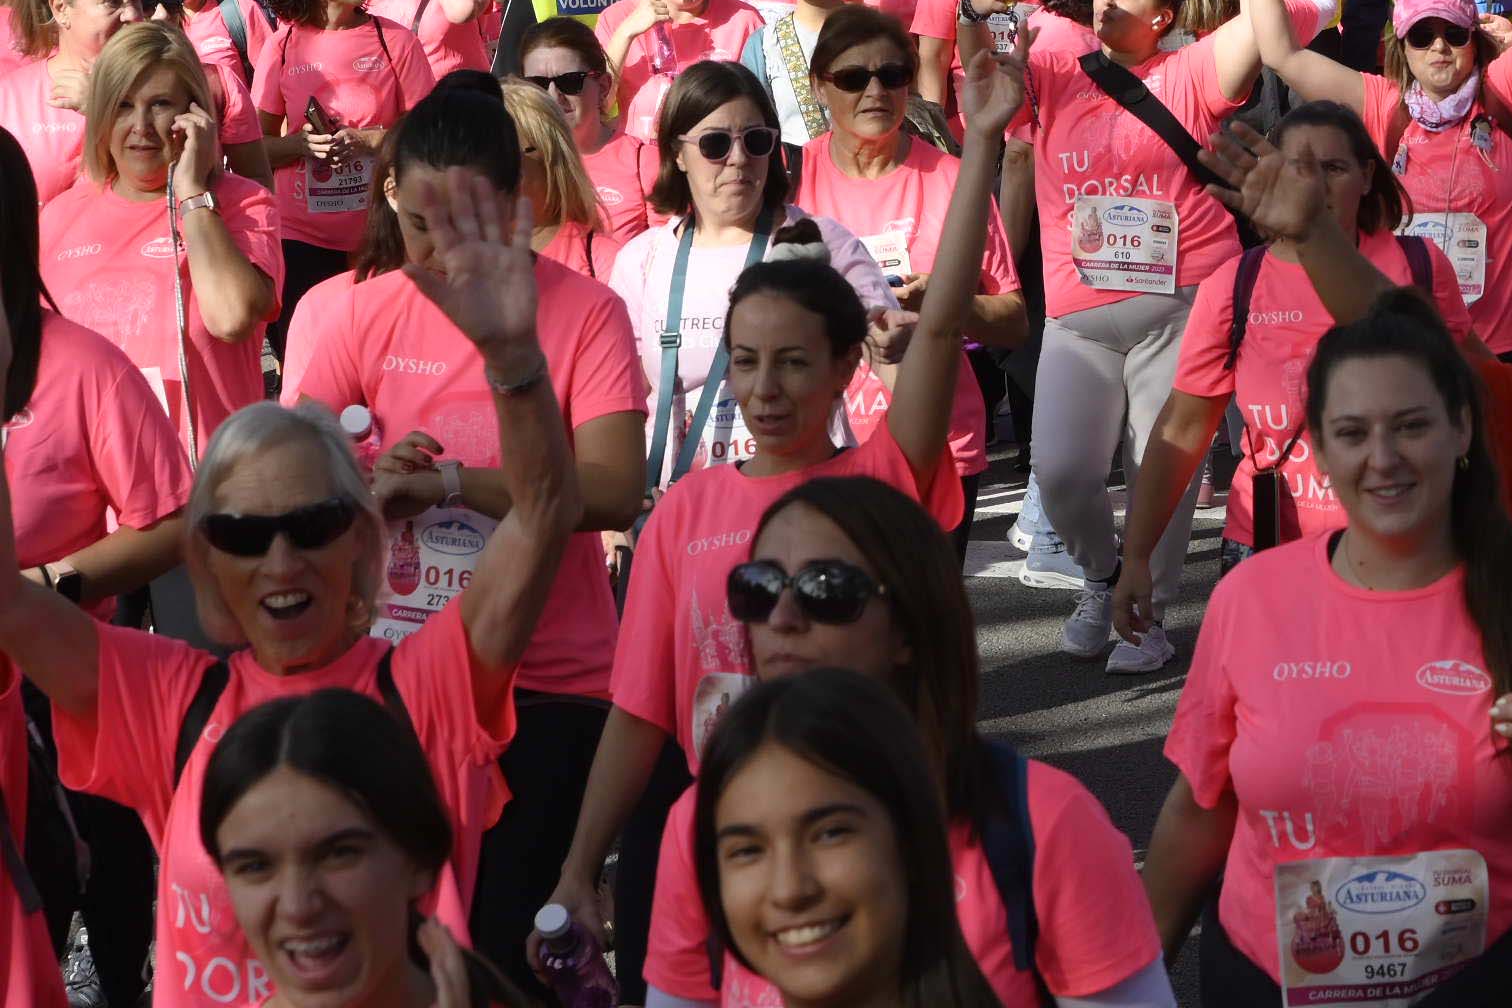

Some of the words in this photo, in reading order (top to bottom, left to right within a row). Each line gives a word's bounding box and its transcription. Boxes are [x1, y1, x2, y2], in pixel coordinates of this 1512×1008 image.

[31, 122, 76, 133] OYSHO
[1058, 150, 1090, 175] TU
[1062, 173, 1163, 205] DORSAL
[1105, 209, 1147, 223] ASTURIANA
[1106, 233, 1142, 248] 016
[1081, 261, 1109, 269] CARRERA
[1114, 251, 1131, 260] 610
[1134, 276, 1168, 286] Santander
[1249, 309, 1303, 326] OYSHO
[383, 354, 447, 377] OYSHO
[1248, 404, 1289, 430] TU
[712, 438, 757, 458] 016
[425, 532, 480, 549] ASTURIANA
[687, 530, 751, 555] OYSHO
[424, 565, 473, 590] 016
[391, 609, 428, 621] CARRERA
[1272, 660, 1352, 682] OYSHO
[1420, 670, 1486, 691] ASTURIANA
[1259, 810, 1317, 851] TU
[1432, 874, 1473, 888] SUMA
[1342, 884, 1420, 906] ASTURIANA
[1350, 928, 1421, 957] 016
[1364, 962, 1408, 980] 9467
[1308, 987, 1366, 1002] CARRERA
[1367, 985, 1384, 998] DE
[1385, 984, 1402, 996] LA
